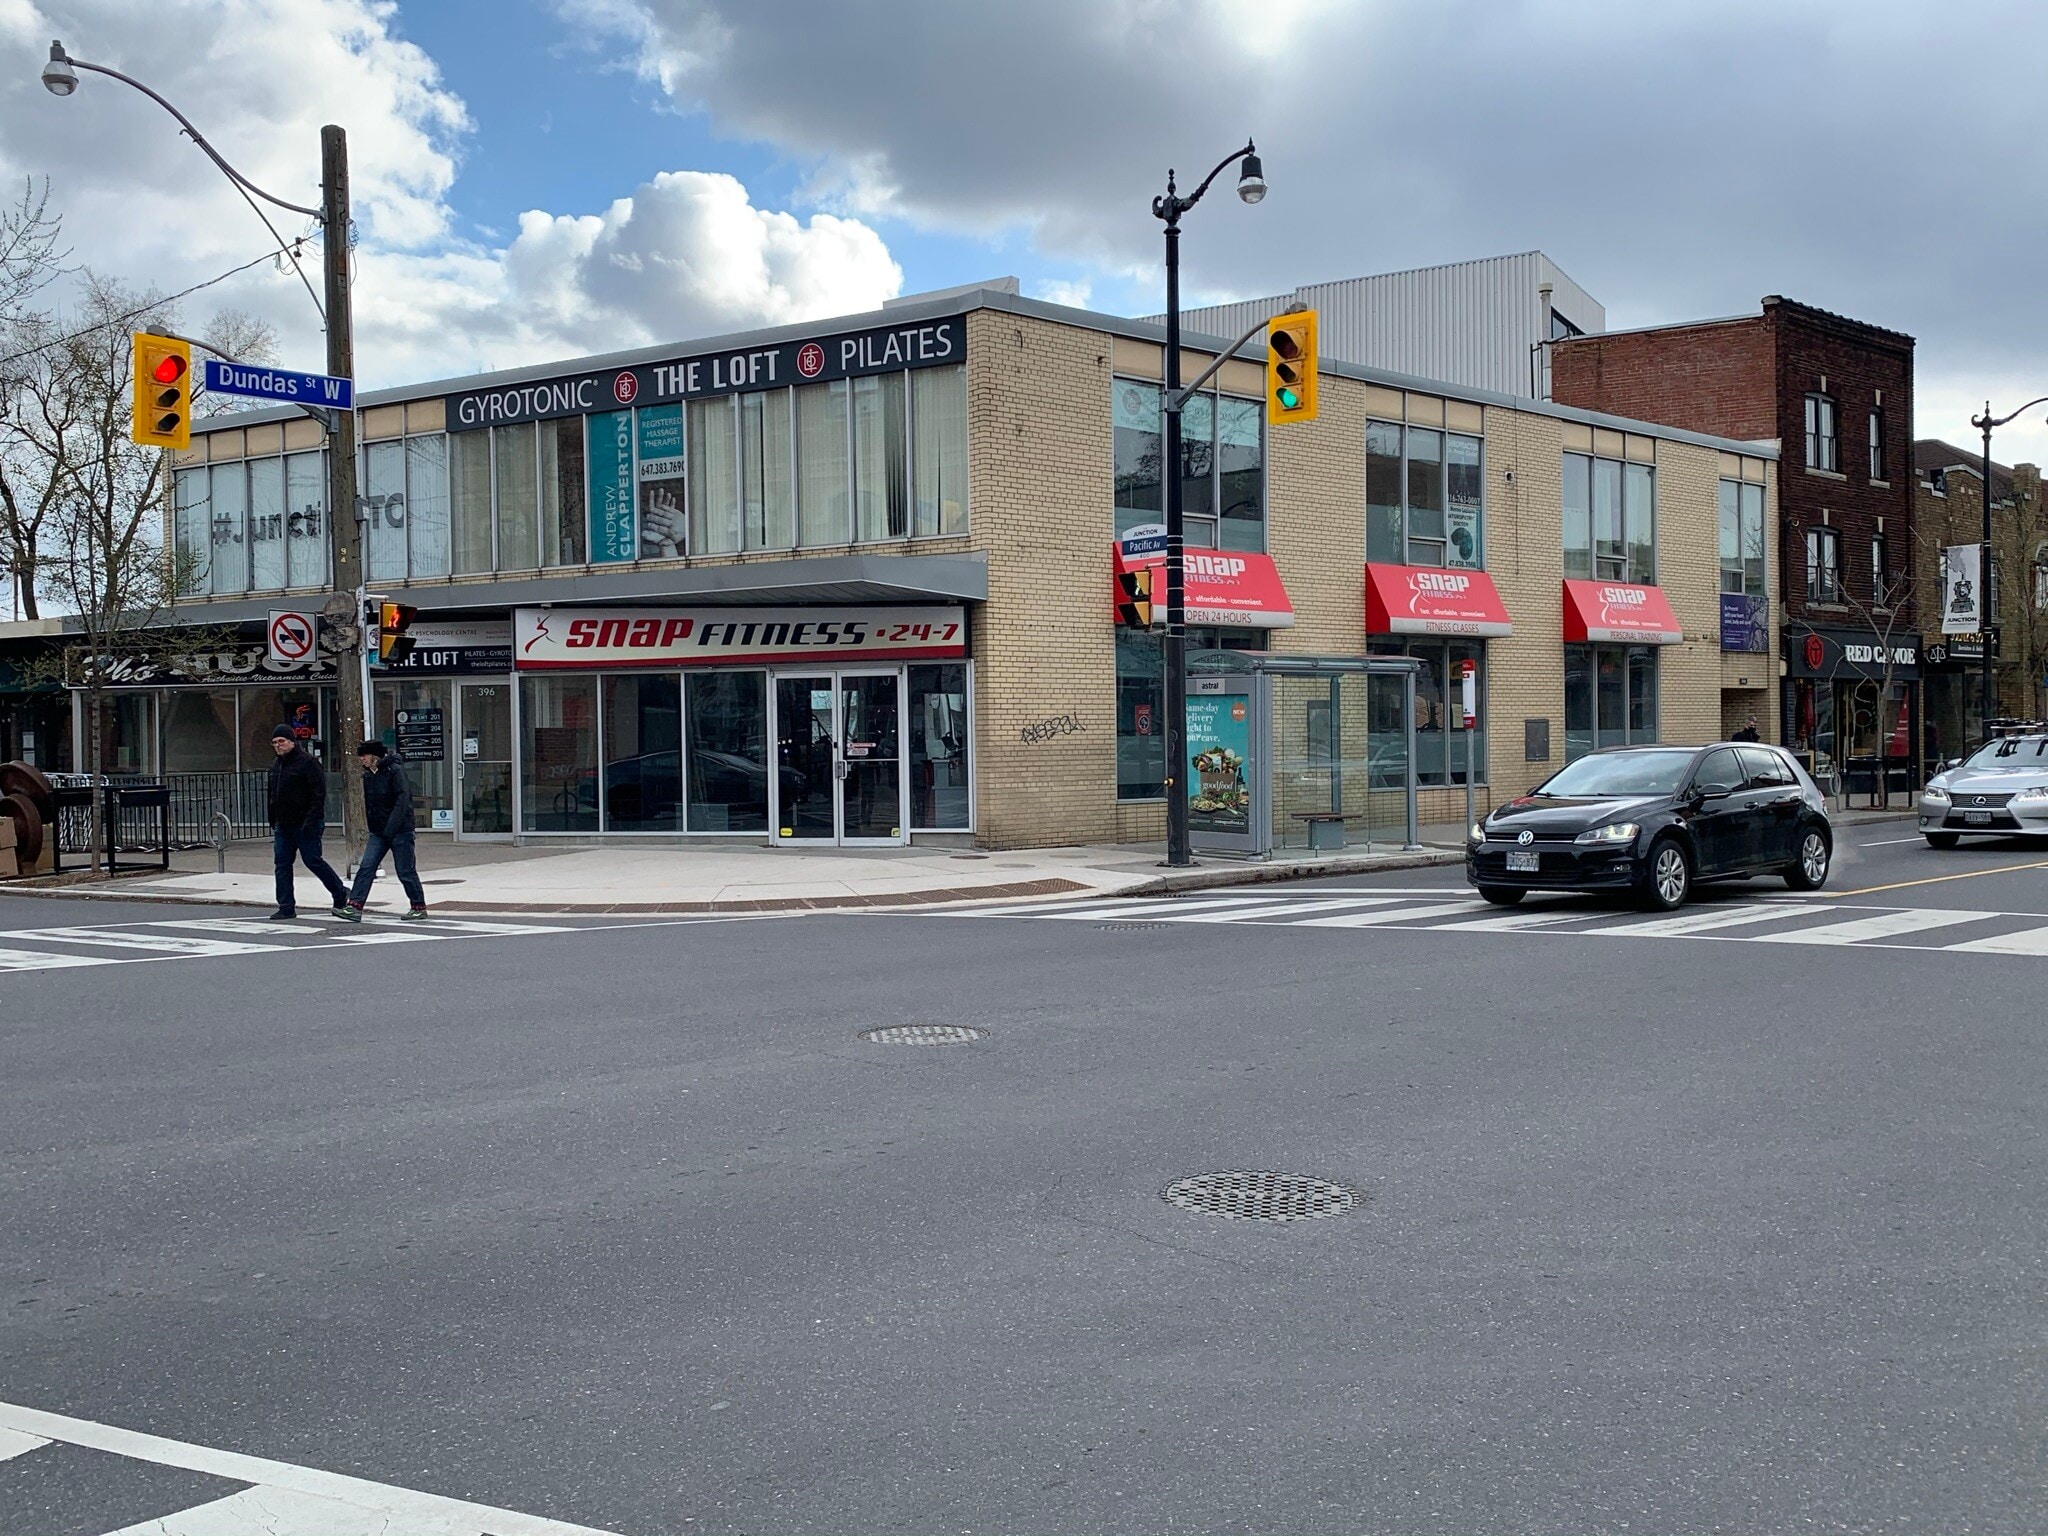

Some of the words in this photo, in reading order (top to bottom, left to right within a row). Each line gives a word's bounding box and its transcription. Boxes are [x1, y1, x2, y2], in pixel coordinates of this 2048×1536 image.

[841, 324, 952, 371] PILATES
[653, 361, 701, 396] THE
[713, 350, 780, 388] LOFT
[219, 365, 298, 395] Dundas
[305, 377, 317, 389] St
[323, 379, 340, 400] W
[642, 417, 682, 428] REGISTERED
[647, 428, 678, 438] MASSAGE
[644, 437, 681, 448] THERAPIST
[617, 415, 631, 557] CLAPPERTON
[605, 485, 617, 557] ANDREW
[1133, 529, 1158, 537] JUNCTION
[1130, 540, 1152, 551] Pacific
[1153, 540, 1161, 549] Av
[1186, 610, 1209, 621] OPEN
[1211, 612, 1221, 622] 24
[1223, 612, 1252, 624] HOURS
[1426, 622, 1452, 633] FITNESS
[1452, 624, 1480, 634] CLASSES
[697, 622, 869, 646] FITNESS
[1610, 631, 1637, 640] PERSONAL
[1638, 632, 1662, 641] TRAINING
[423, 651, 459, 666] LOFT
[1844, 645, 1872, 662] RED
[250, 674, 305, 682] Vietnamese
[310, 672, 338, 680] Cuisi
[1201, 682, 1219, 690] astral
[479, 688, 495, 696] 396
[1186, 713, 1214, 724] elivery
[1187, 723, 1202, 733] ight
[1203, 724, 1212, 732] to
[1202, 780, 1234, 791] goodfood
